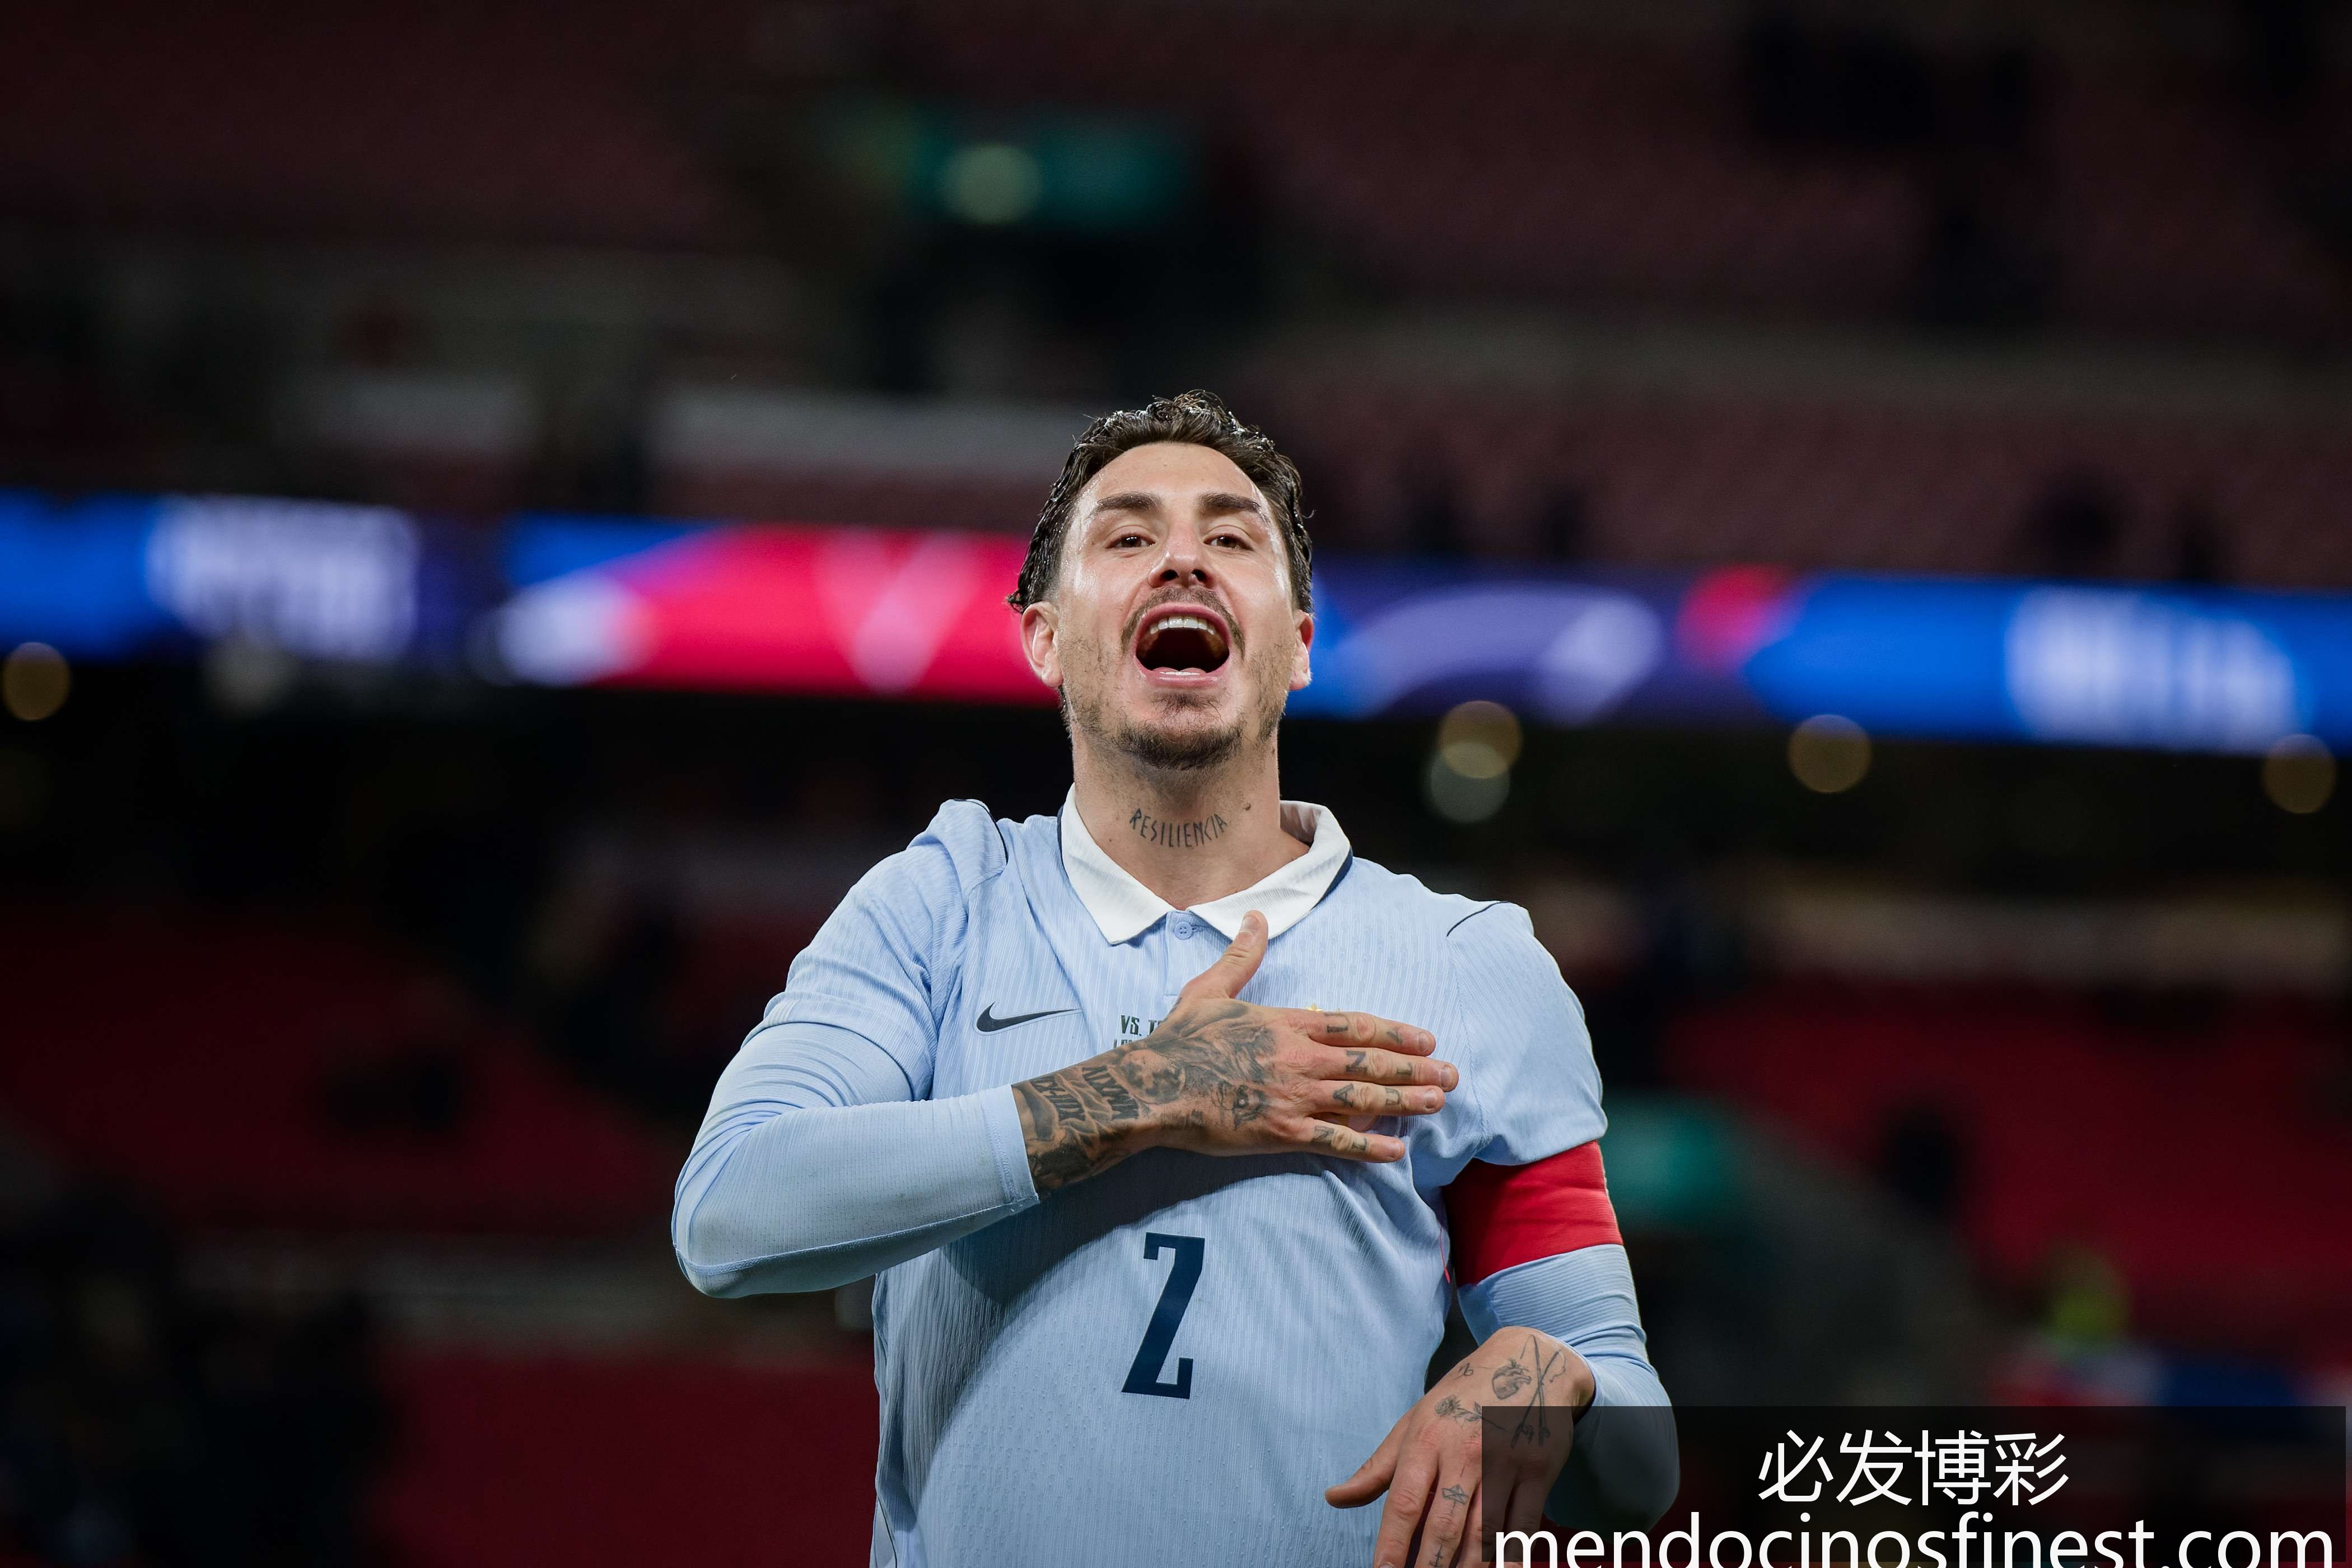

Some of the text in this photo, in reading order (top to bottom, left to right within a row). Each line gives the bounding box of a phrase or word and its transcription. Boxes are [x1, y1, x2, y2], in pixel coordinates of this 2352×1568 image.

[1130, 808, 1227, 847] RESILIENCIA
[1121, 1015, 1163, 1037] VS. T
[1121, 1232, 1205, 1399] 2
